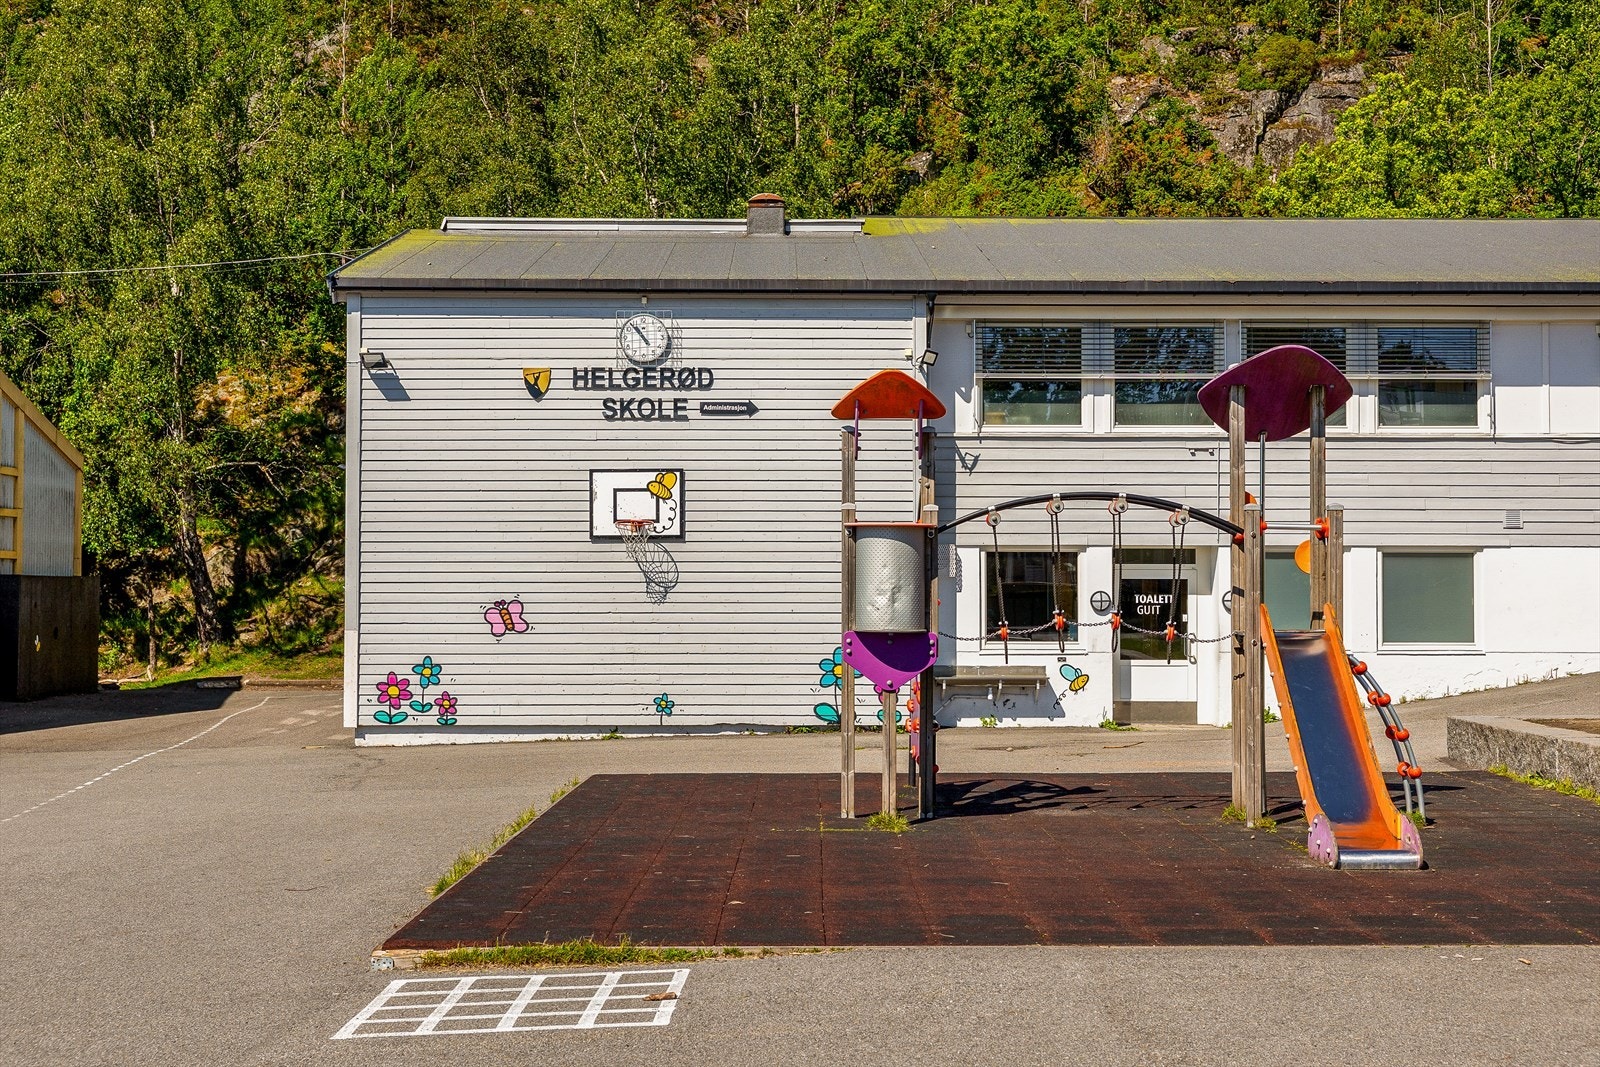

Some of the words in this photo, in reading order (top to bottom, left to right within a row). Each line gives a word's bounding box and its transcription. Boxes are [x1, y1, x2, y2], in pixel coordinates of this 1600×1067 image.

[572, 367, 714, 391] HELGERØD
[602, 397, 689, 421] SKOLE
[1137, 605, 1160, 614] GUTT
